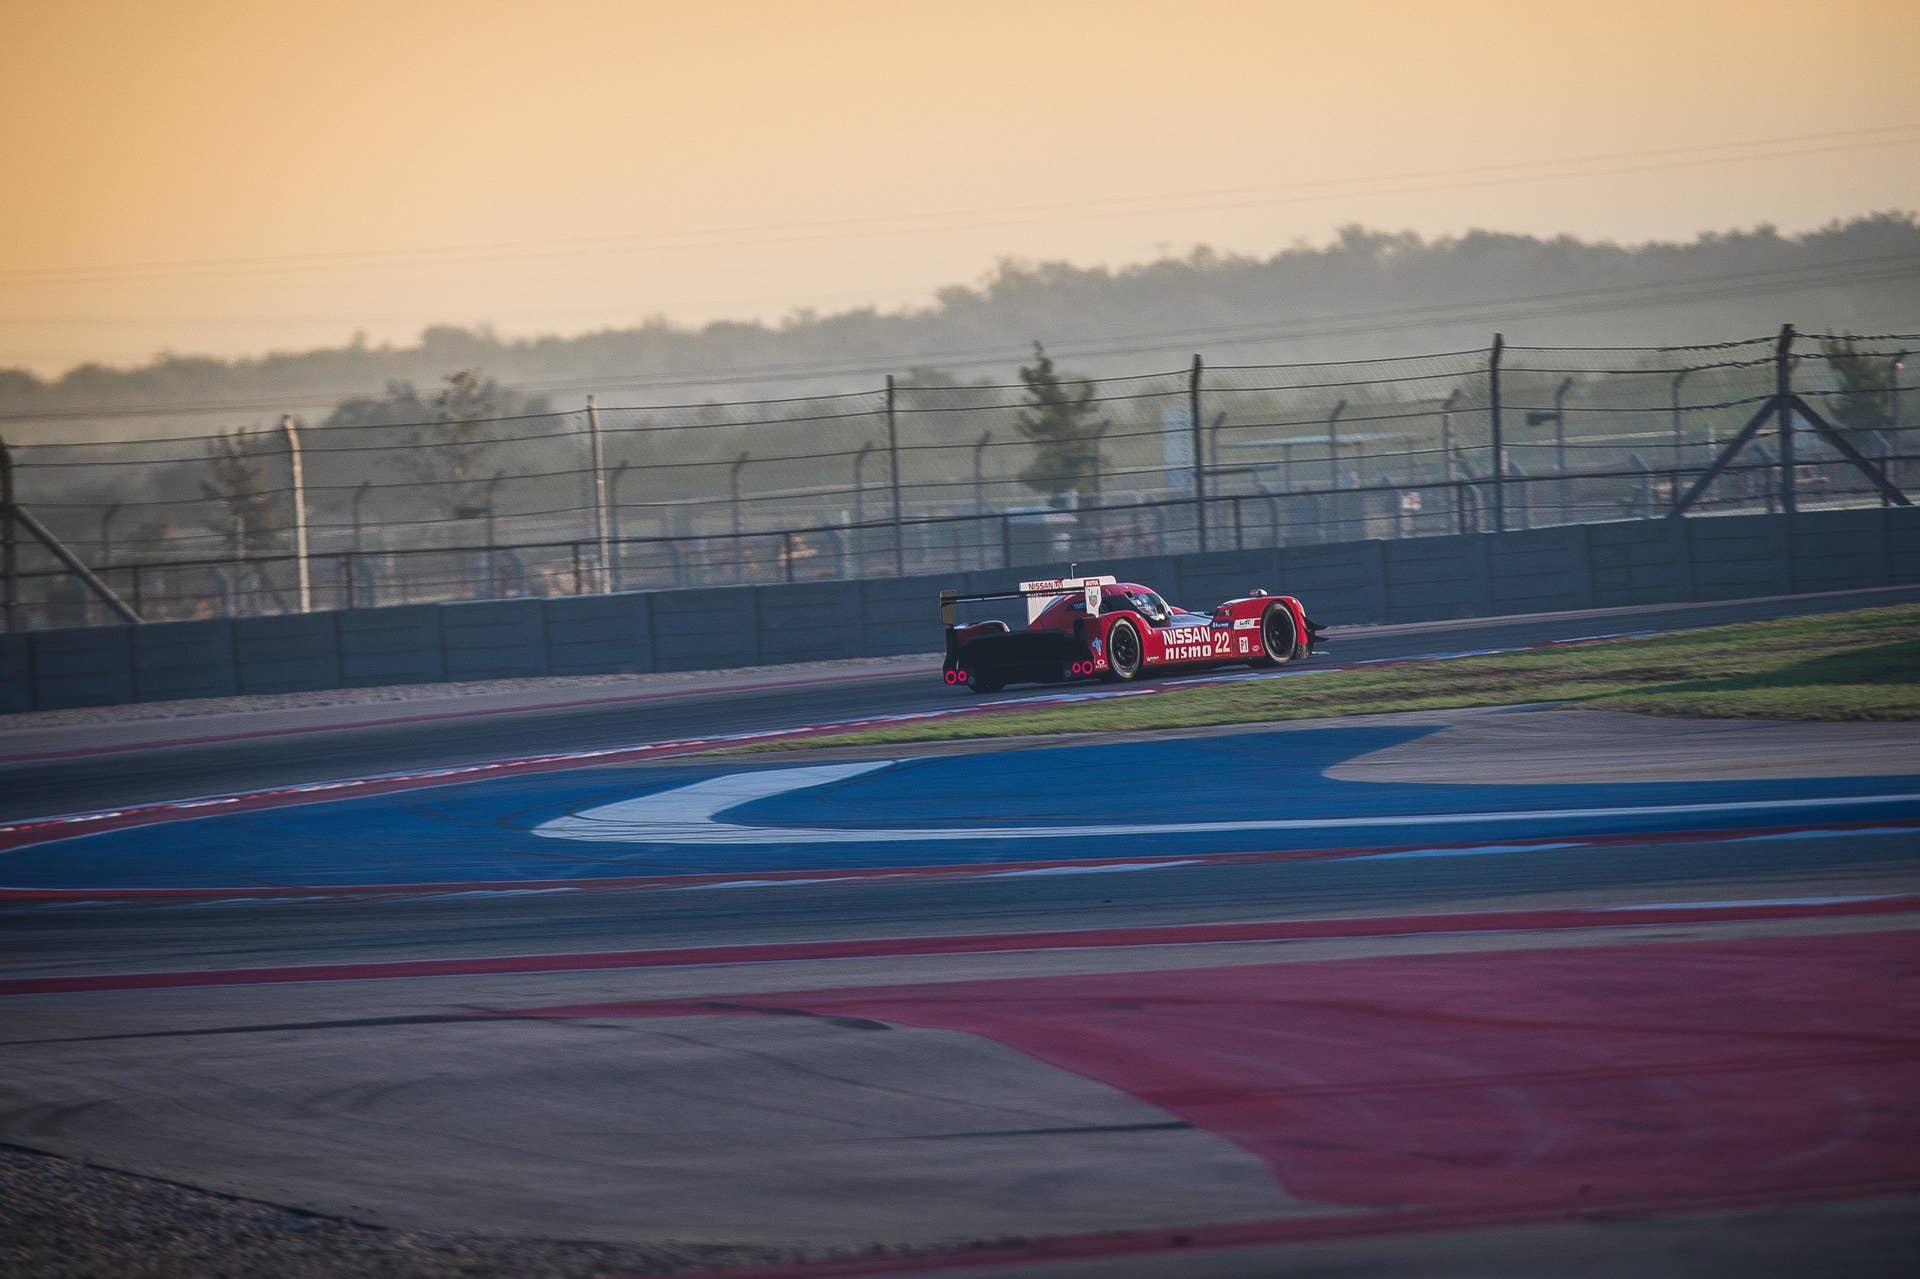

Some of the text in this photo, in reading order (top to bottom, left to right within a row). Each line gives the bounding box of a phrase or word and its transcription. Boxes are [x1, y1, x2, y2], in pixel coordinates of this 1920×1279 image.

[1029, 581, 1053, 590] NISSAN
[1162, 626, 1211, 645] NISSAN
[1214, 631, 1231, 653] 22
